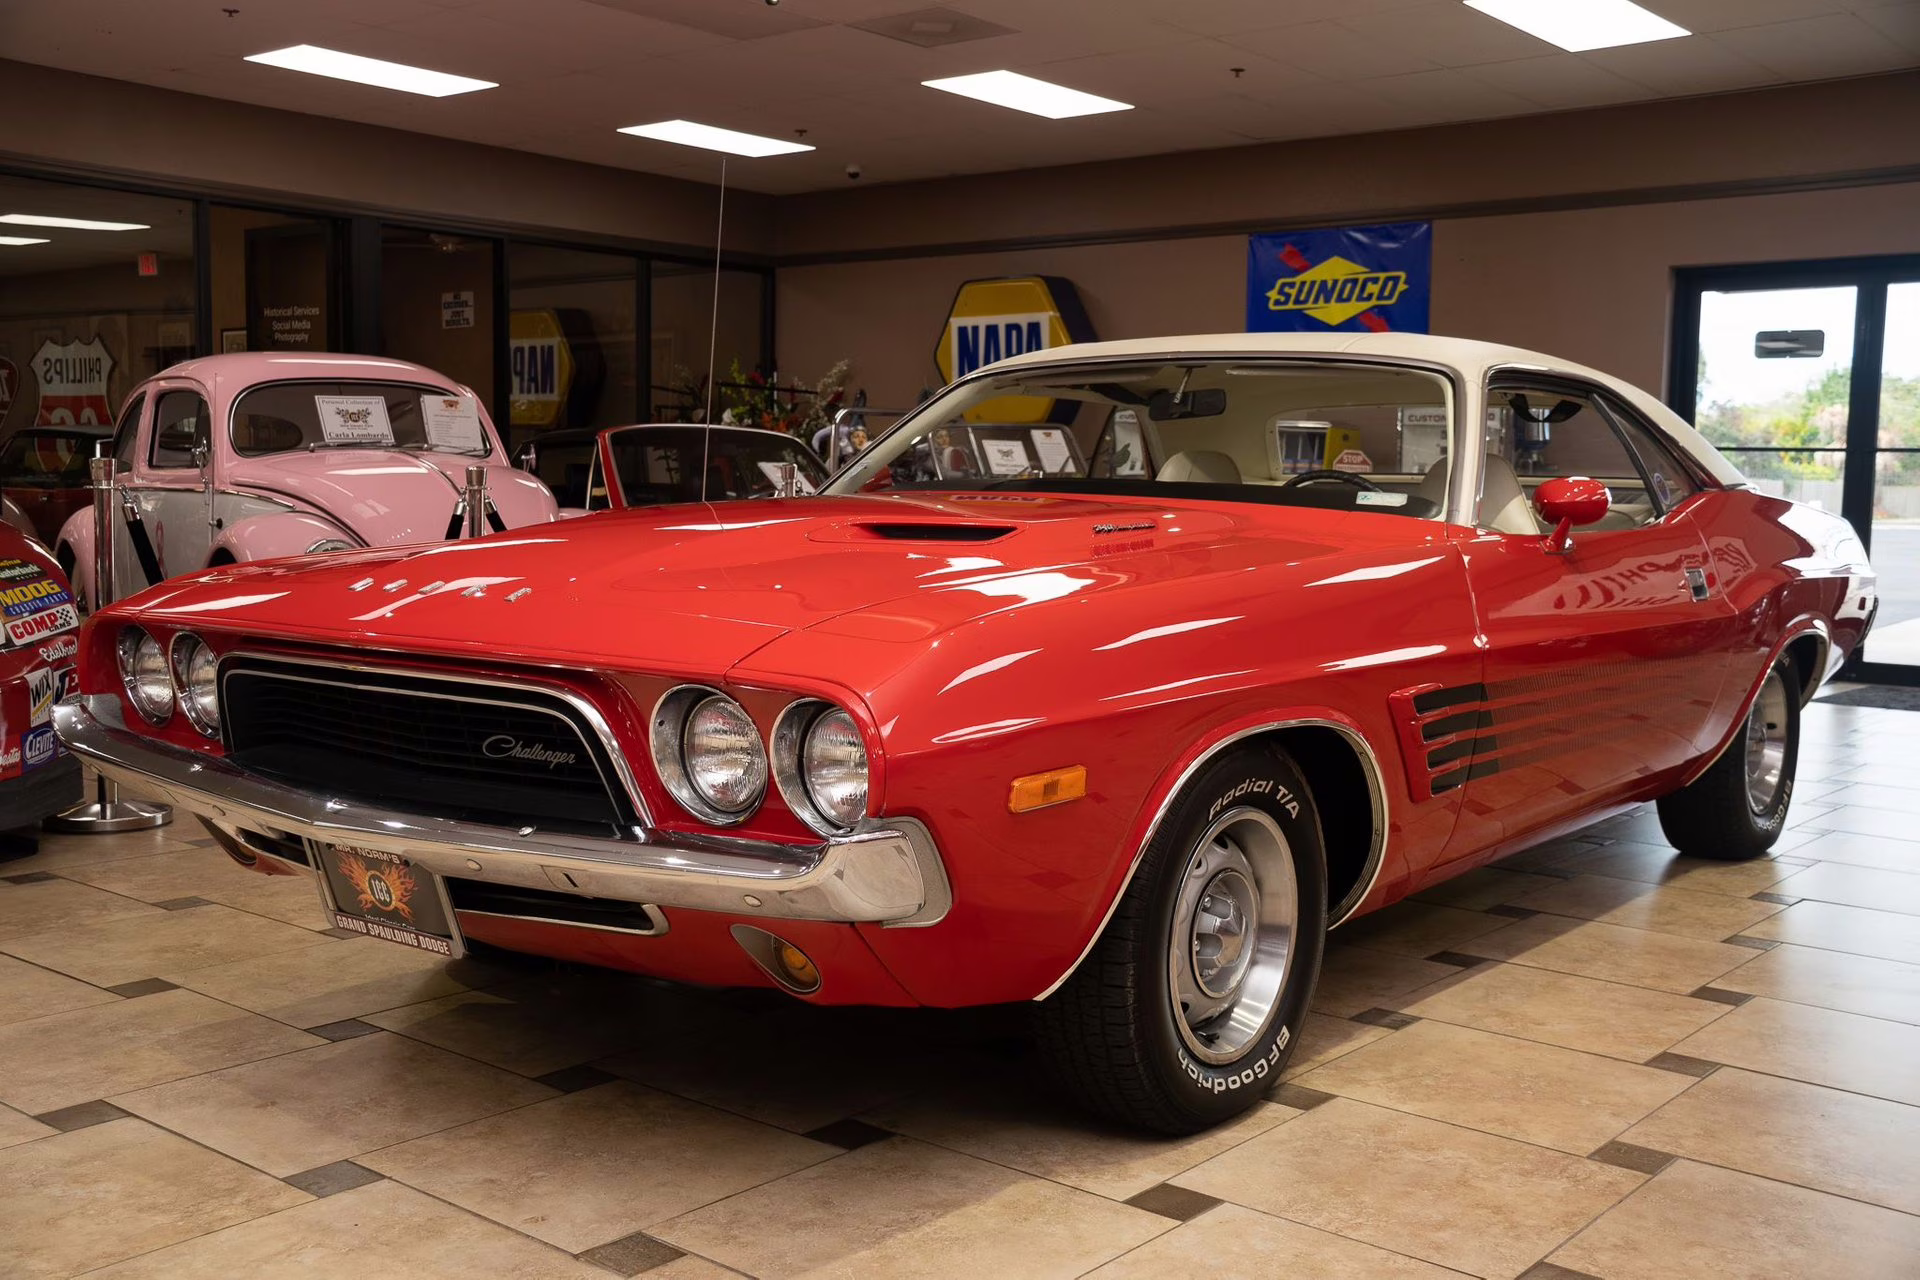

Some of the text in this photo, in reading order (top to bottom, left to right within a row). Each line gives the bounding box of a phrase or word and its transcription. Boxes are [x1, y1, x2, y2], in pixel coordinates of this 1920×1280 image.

[1273, 275, 1402, 306] SUNOCO
[263, 305, 320, 318] Historical Services
[272, 320, 311, 331] Social Media
[274, 331, 309, 343] Photography
[1343, 455, 1363, 463] STOP
[0, 579, 62, 607] MOOG
[10, 612, 59, 640] COMP
[48, 620, 72, 633] CAMS
[31, 671, 52, 707] WIX
[25, 731, 55, 759] CLEVITE
[482, 735, 576, 770] Challenger
[1208, 777, 1301, 822] Radial T/A
[335, 843, 401, 864] MR. NORM'S
[371, 879, 391, 903] ICC
[336, 915, 450, 956] GRAND SPAULDING DODGE
[1177, 1025, 1291, 1094] BFGoodrich
